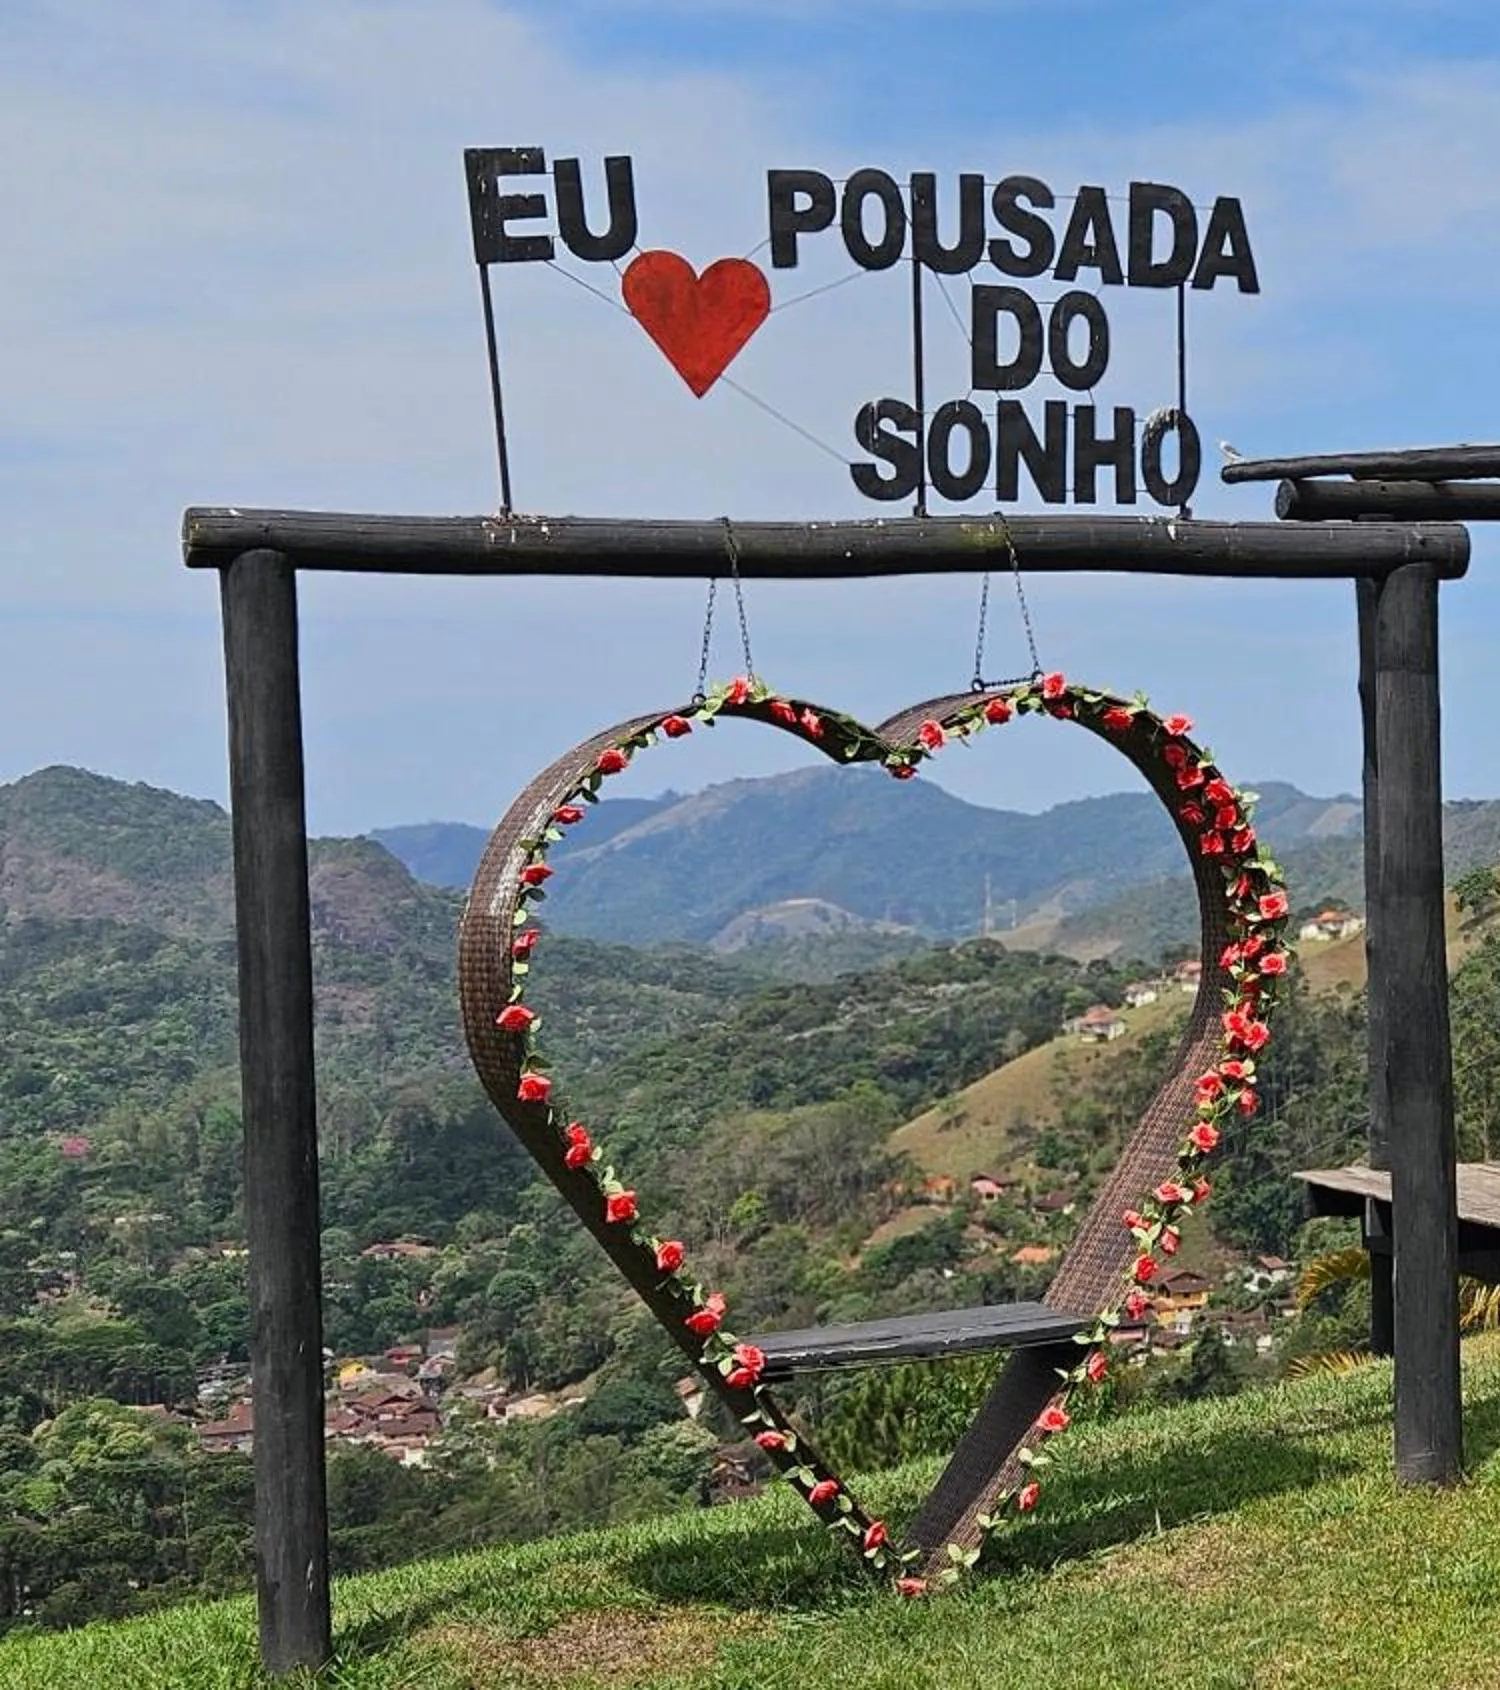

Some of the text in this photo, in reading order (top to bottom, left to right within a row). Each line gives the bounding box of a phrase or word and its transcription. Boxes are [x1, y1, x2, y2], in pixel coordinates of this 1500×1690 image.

[464, 147, 1260, 294] EU POUSADA
[972, 284, 1109, 391] DO
[850, 398, 1201, 507] SONHO
